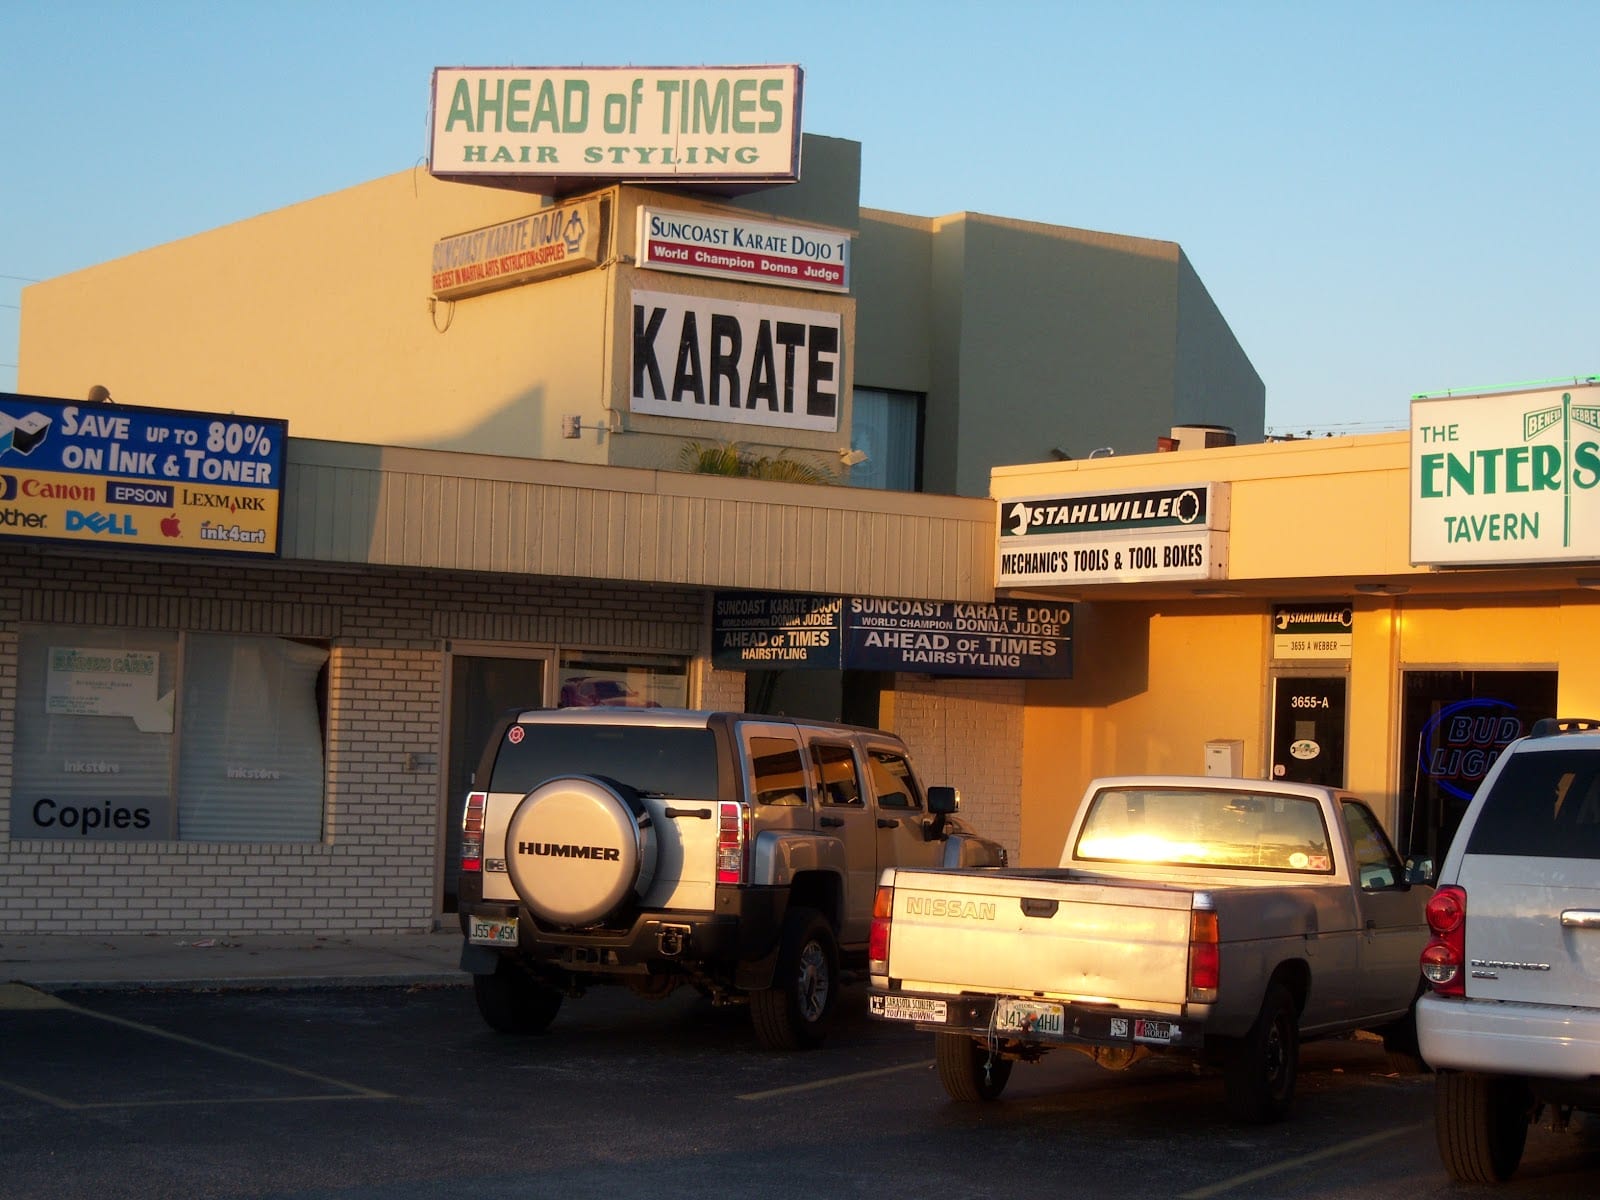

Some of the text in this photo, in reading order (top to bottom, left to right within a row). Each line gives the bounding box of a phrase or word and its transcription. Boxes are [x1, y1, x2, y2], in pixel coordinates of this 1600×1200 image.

[444, 78, 784, 134] AHEAD of TIMES
[463, 145, 760, 165] HAIR STYLING
[433, 210, 564, 272] SUNCOAST KARATE DOJO
[652, 216, 844, 261] SUNCOAST KARATE DOJO 1
[462, 263, 485, 284] MARTIAL
[486, 259, 499, 277] ARTS
[654, 246, 839, 281] World Champion Donna Judge
[634, 304, 838, 418] KARATE
[1572, 408, 1600, 428] WEBBE
[61, 406, 272, 456] SAVE UP TO 80%
[1420, 424, 1458, 442] THE
[62, 443, 272, 484] ON INK & TONER
[22, 479, 265, 512] Canon EPSON LEXMARK
[1032, 498, 1172, 526] STAHLWILLE
[65, 510, 137, 536] DELL
[200, 525, 266, 543] ink4art
[1444, 512, 1538, 543] TAVERN
[1002, 544, 1202, 574] MECHANIC'S TOOLS & TOOL BOXES
[718, 598, 840, 615] SUNCOAST KARATE DOJO
[851, 598, 1070, 624] SUNCOAST KARATE DOJO
[771, 615, 800, 626] DONNA
[803, 614, 832, 626] JUDGE
[862, 617, 1060, 636] WORLD CHAMPION DONNA JUDGE
[723, 631, 830, 647] AHEAD OF TIMES
[864, 632, 1056, 656] AHEAD OF TIMES
[1291, 642, 1305, 650] 3655
[1313, 641, 1338, 650] WEBBER
[742, 648, 807, 660] HAIRSTYLING
[902, 650, 1020, 667] HAIRSTYLING
[1292, 696, 1328, 708] 3655-A
[1448, 716, 1520, 744] BUD
[1430, 748, 1498, 776] LIG
[32, 799, 150, 835] Copies
[518, 842, 620, 861] HUMMER
[907, 897, 996, 920] NISSAN
[886, 1009, 934, 1020] YOUTH ROWING
